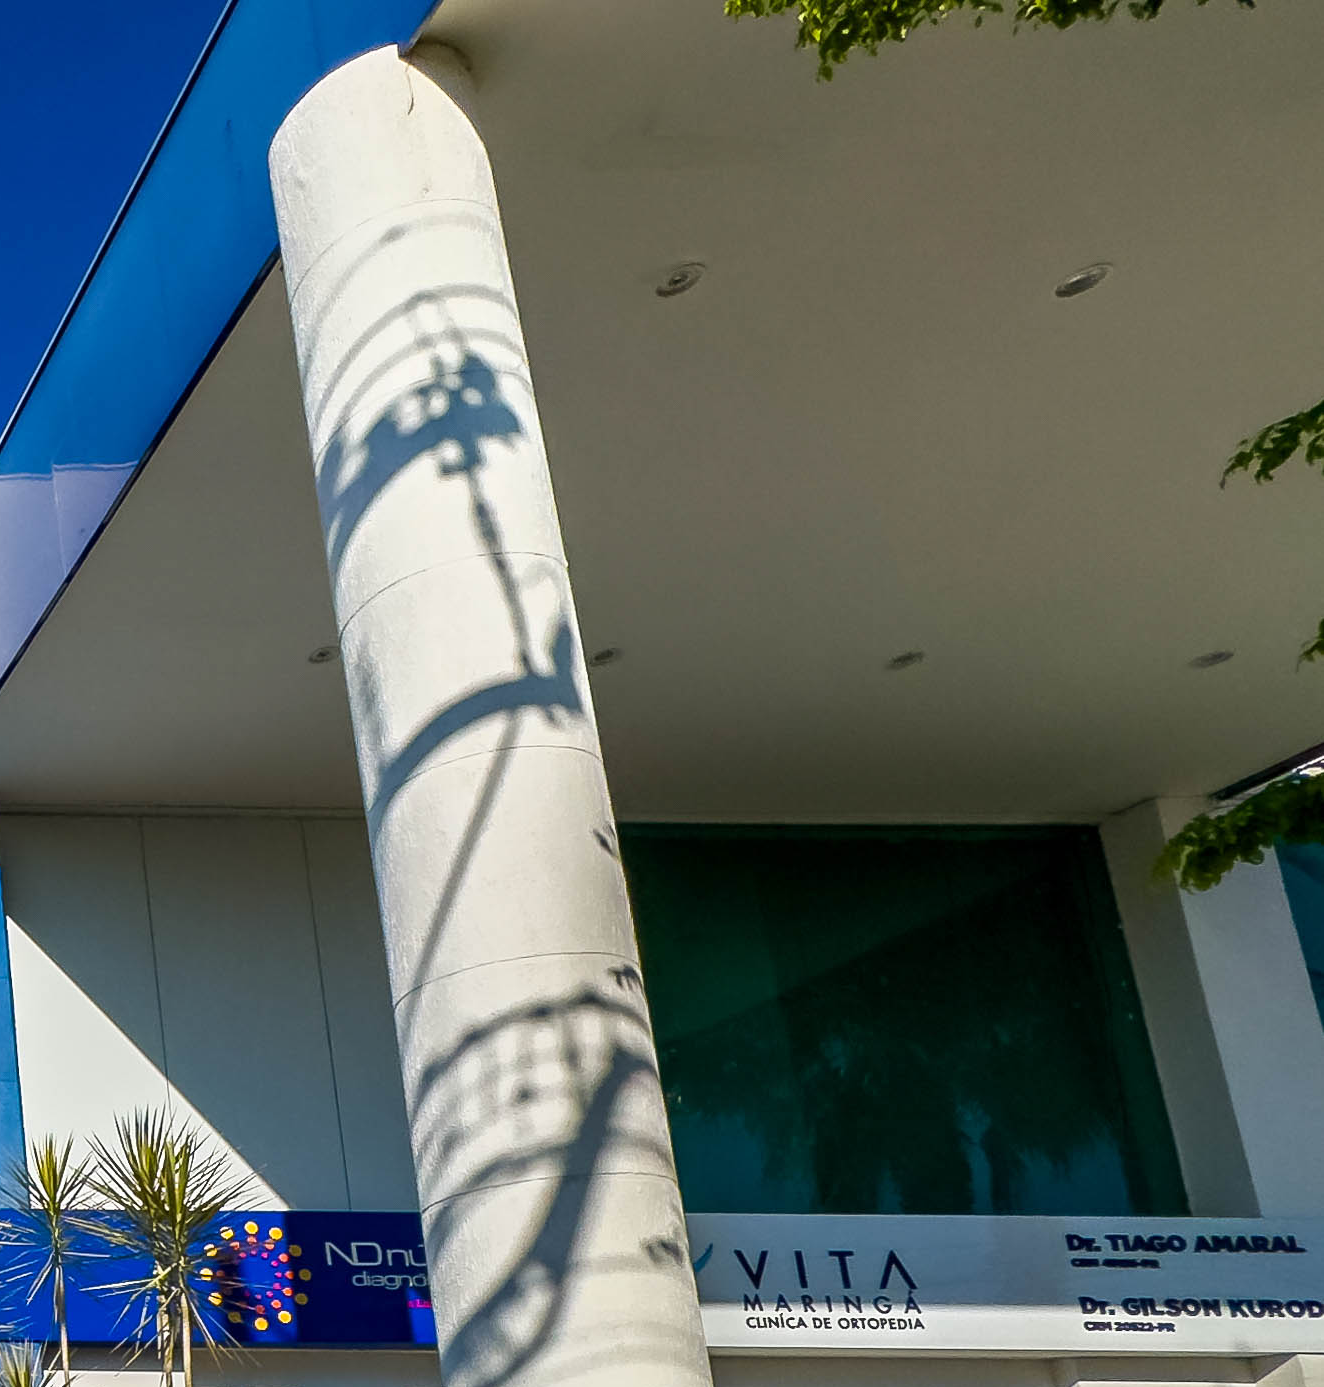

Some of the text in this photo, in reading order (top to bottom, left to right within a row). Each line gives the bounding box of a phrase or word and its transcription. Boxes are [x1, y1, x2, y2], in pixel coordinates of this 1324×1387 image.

[1065, 1233, 1307, 1253] Dr. TIAGO AMARAL
[324, 1242, 382, 1267] ND
[733, 1249, 918, 1290] VITA
[742, 1290, 922, 1314] MARINGÁ
[1078, 1296, 1115, 1315] Dr.
[1121, 1297, 1222, 1317] GILSON
[812, 1317, 832, 1329] DE
[838, 1317, 925, 1330] ORTOPEDIA
